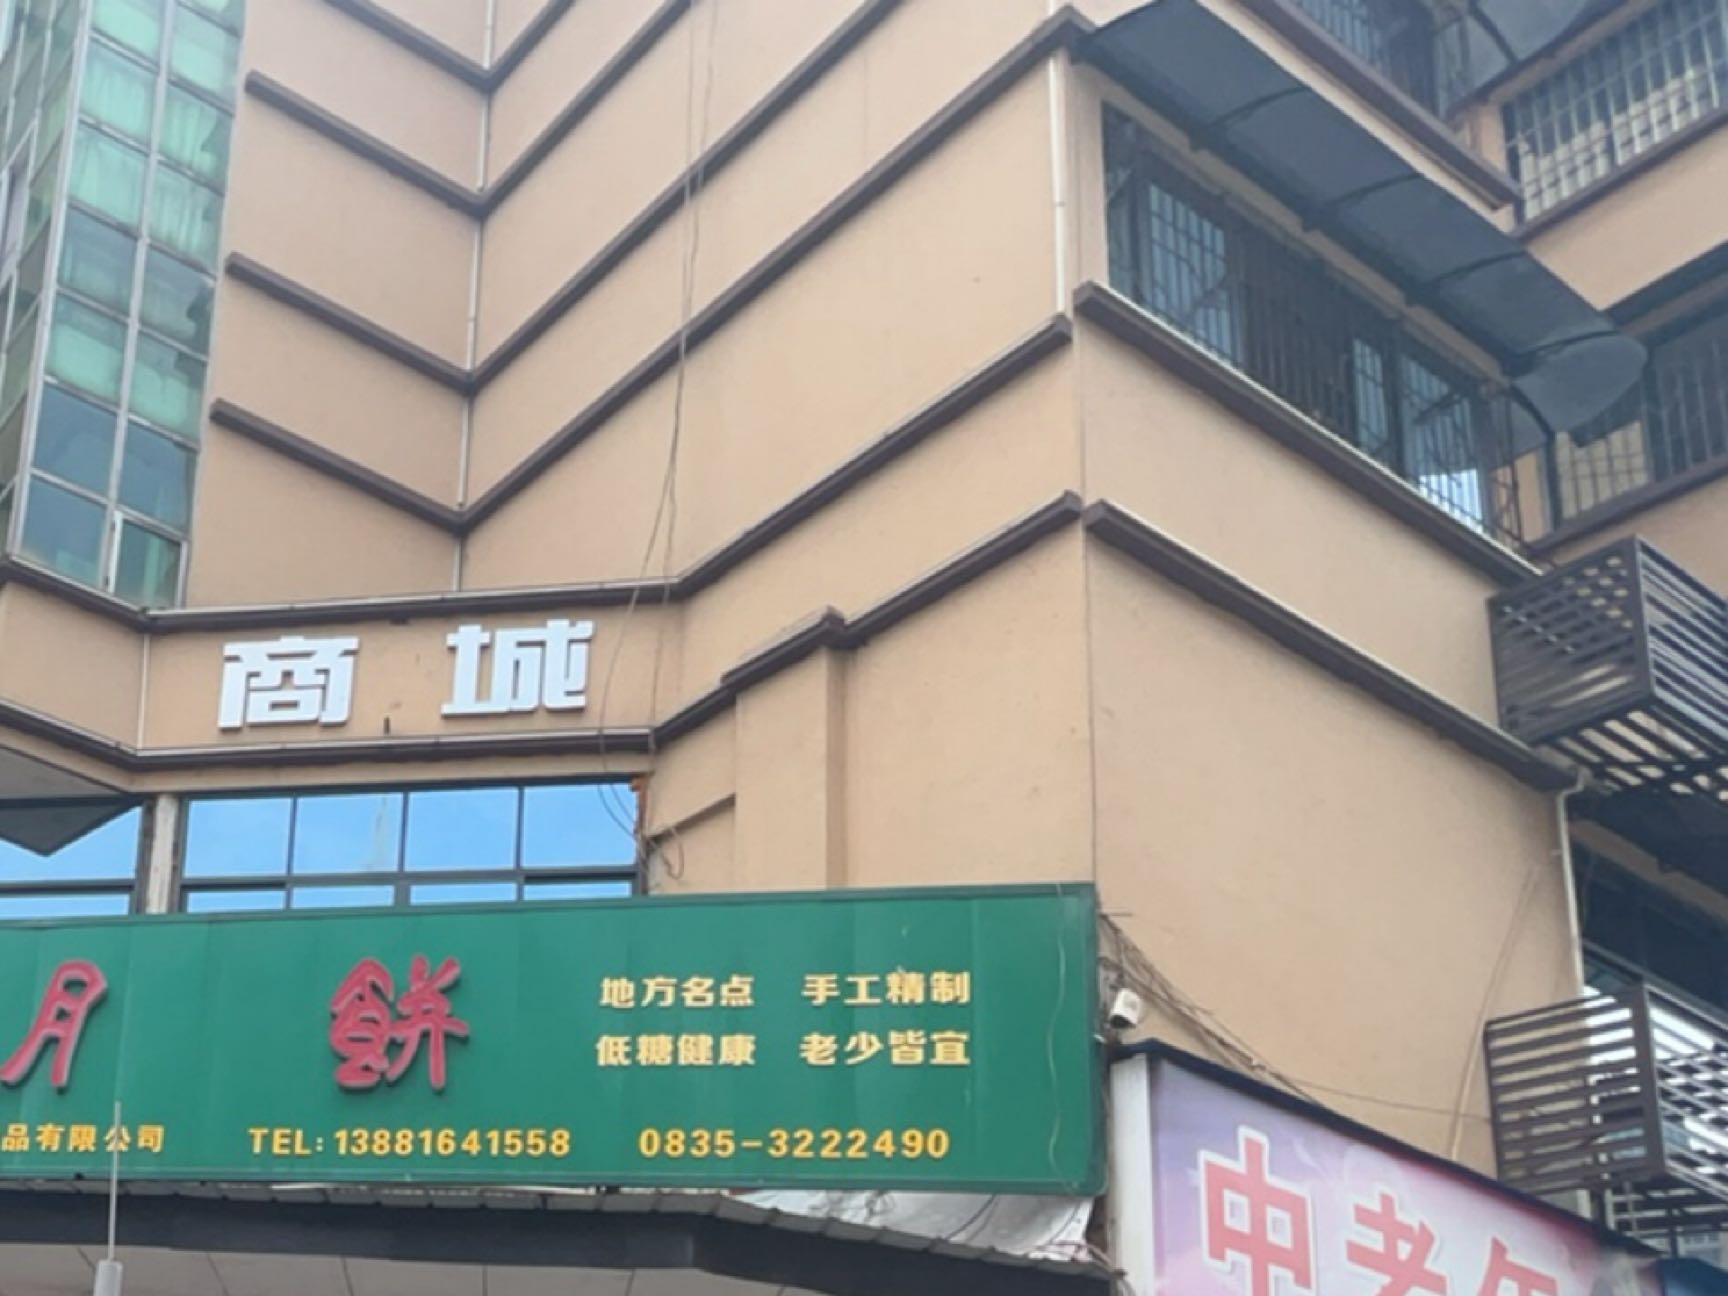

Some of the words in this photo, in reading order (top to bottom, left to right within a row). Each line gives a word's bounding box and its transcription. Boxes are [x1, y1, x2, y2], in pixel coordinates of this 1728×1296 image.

[599, 974, 755, 1009] 地方名点
[800, 970, 971, 1006] 手工精制
[596, 1034, 756, 1067] 低糖健康
[799, 1029, 971, 1066] 老少皆宜
[638, 1126, 951, 1158] 0835-3222490
